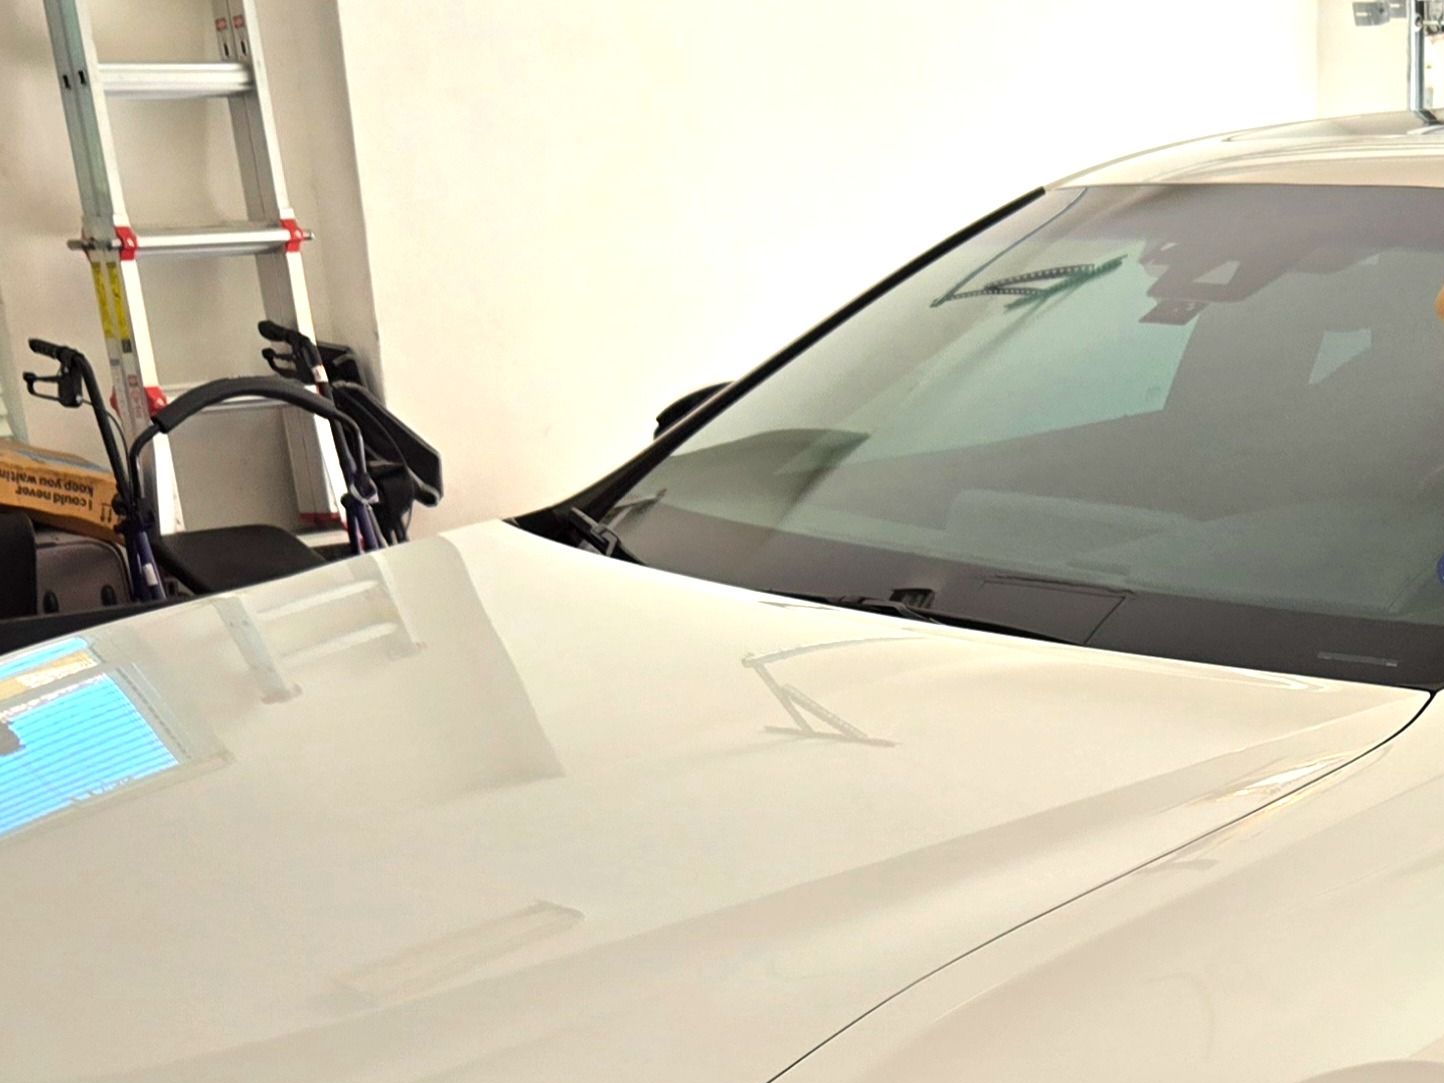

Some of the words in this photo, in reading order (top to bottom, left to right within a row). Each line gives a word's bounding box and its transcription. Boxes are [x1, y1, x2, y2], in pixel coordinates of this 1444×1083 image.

[39, 477, 62, 490] you
[64, 480, 94, 498] keep
[15, 486, 51, 500] never
[53, 493, 87, 506] could
[88, 499, 93, 511] I
